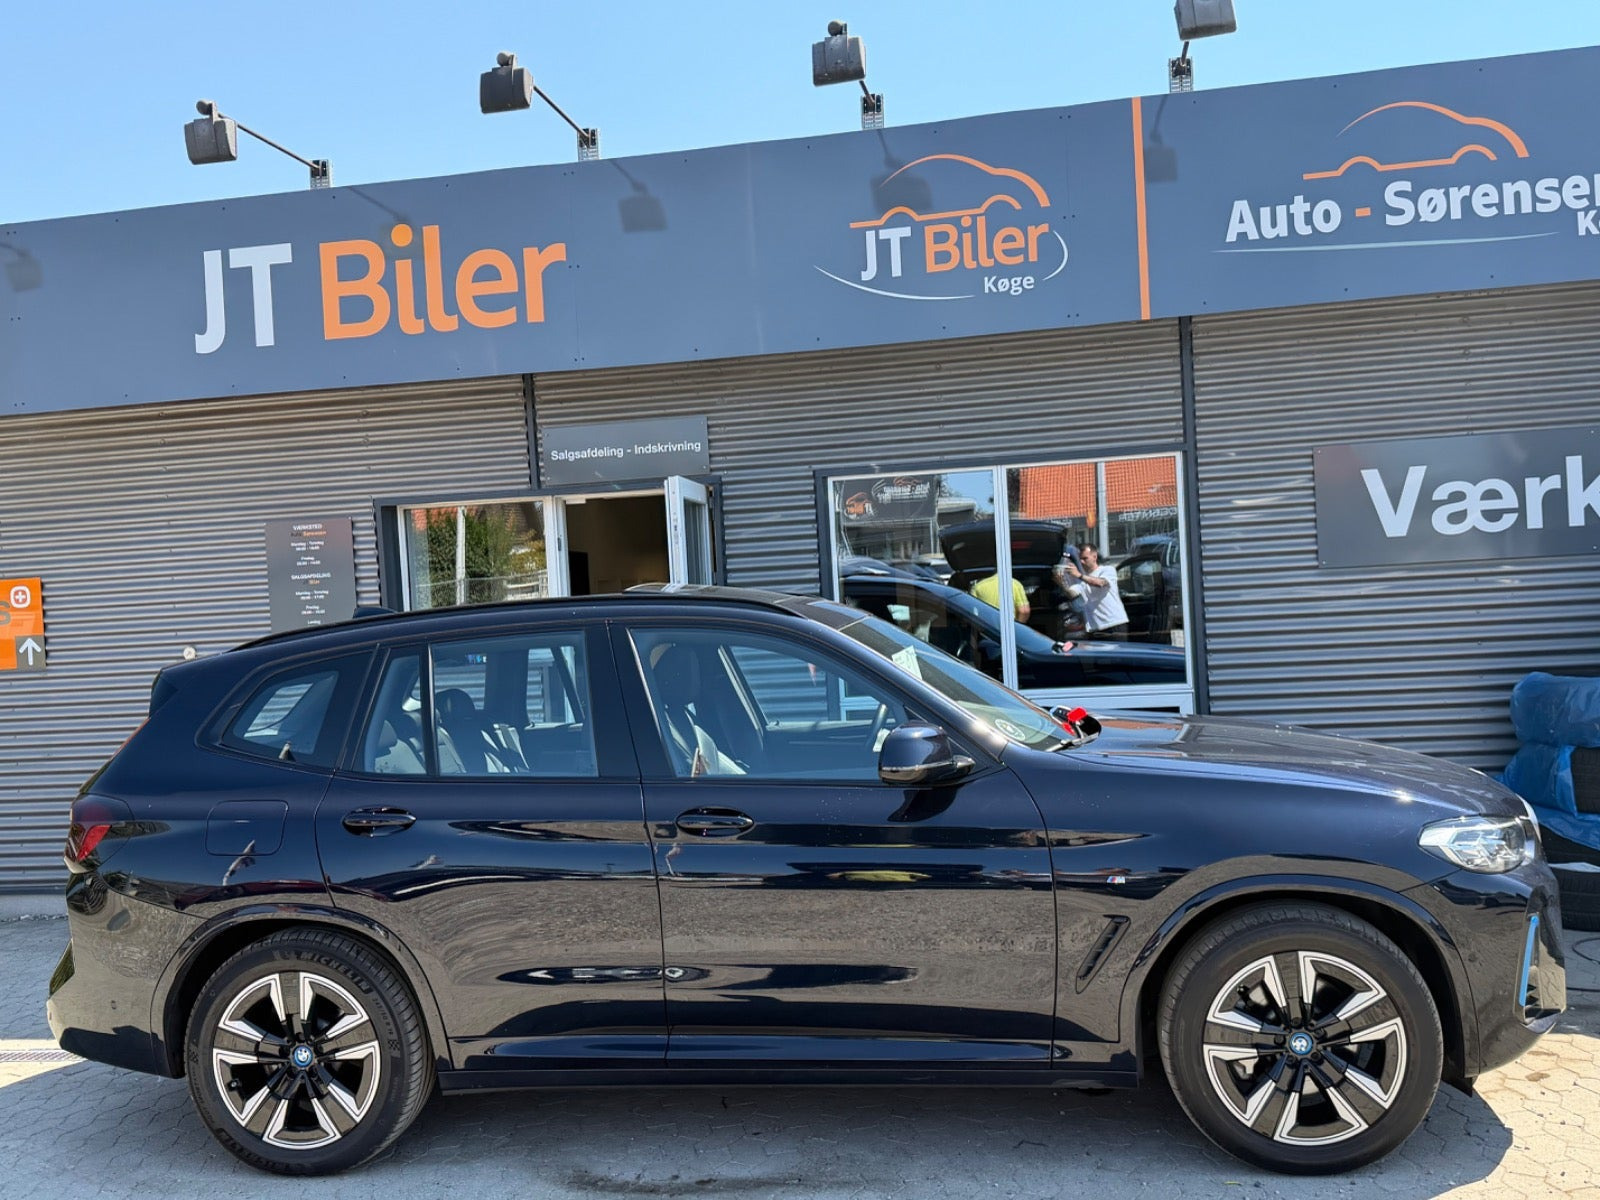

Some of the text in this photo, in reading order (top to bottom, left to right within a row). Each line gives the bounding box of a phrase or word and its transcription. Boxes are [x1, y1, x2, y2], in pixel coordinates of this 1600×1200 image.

[1225, 172, 1600, 243] Auto - Sørense
[1577, 210, 1600, 236] K
[861, 215, 1049, 281] JT Biler
[195, 223, 566, 354] JT Biler
[984, 275, 1035, 295] Køge
[550, 446, 624, 462] Salgsafdeling
[634, 440, 701, 455] Indskrivning
[1360, 455, 1600, 538] Værk
[300, 950, 372, 990] MICHELIN
